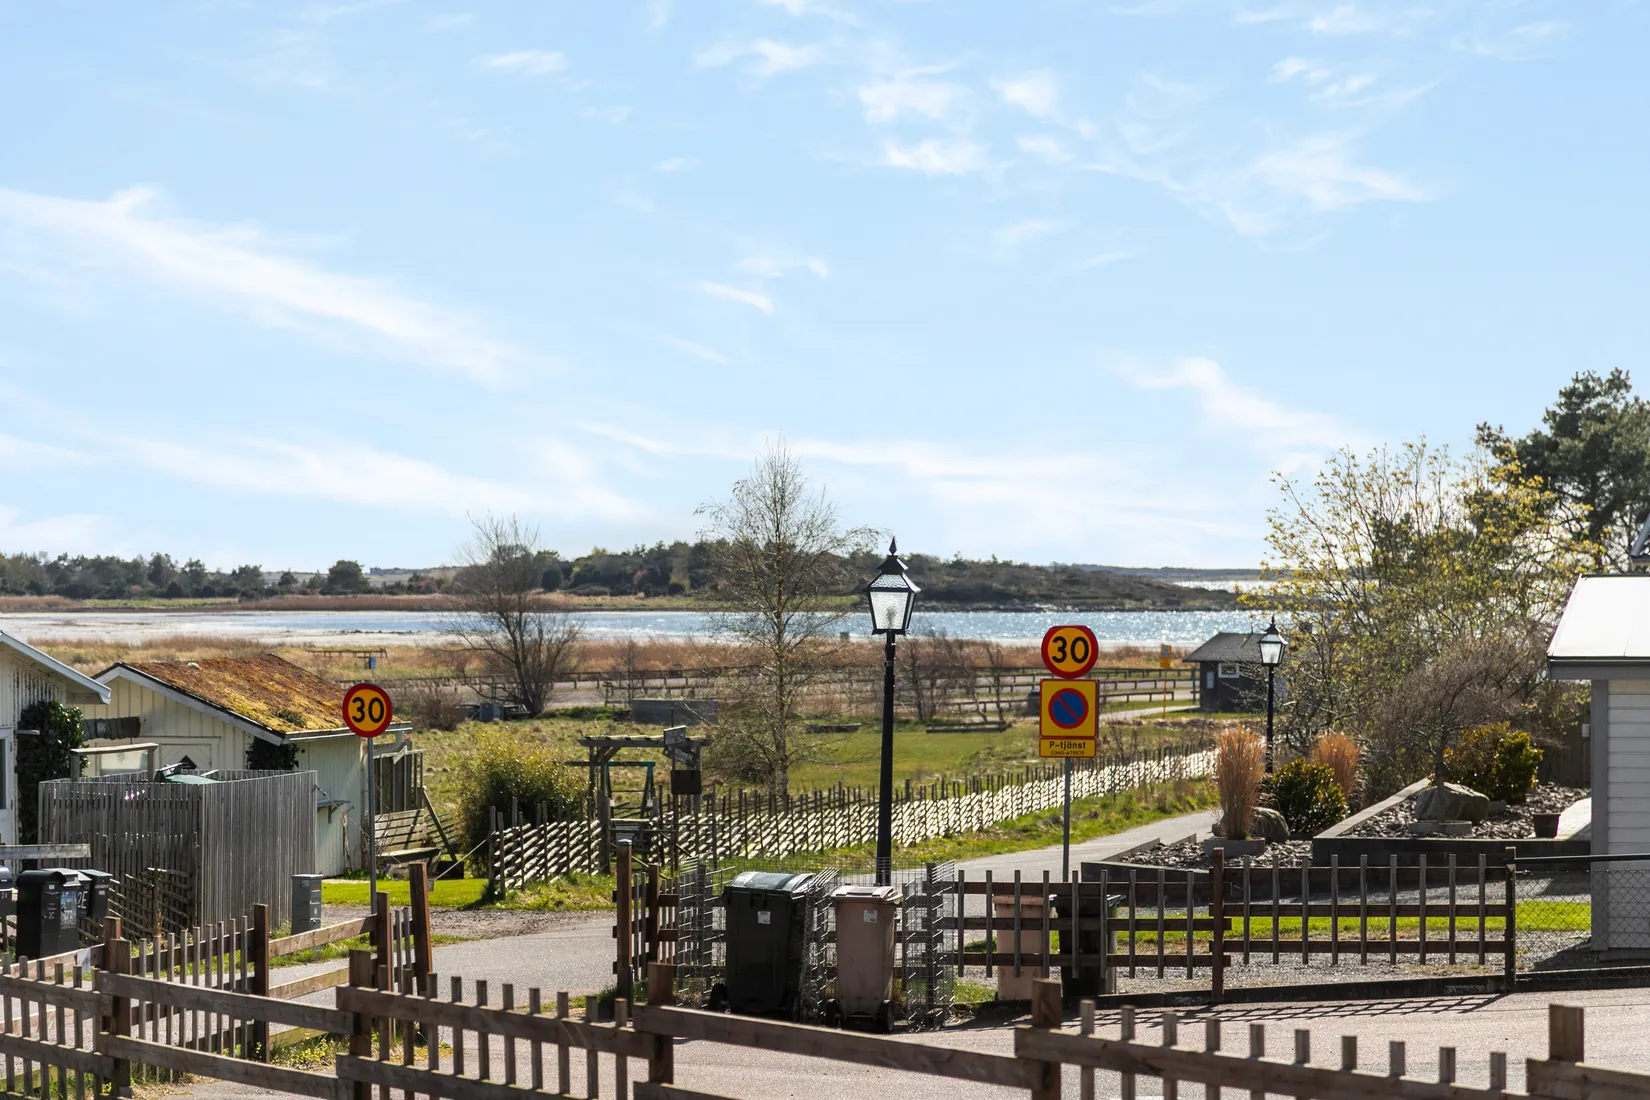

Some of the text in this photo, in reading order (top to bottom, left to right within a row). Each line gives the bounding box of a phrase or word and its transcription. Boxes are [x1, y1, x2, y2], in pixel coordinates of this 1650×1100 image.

[1051, 636, 1090, 664] 30
[351, 696, 385, 723] 30
[1049, 740, 1086, 750] P-tjänst
[77, 890, 88, 909] 2E
